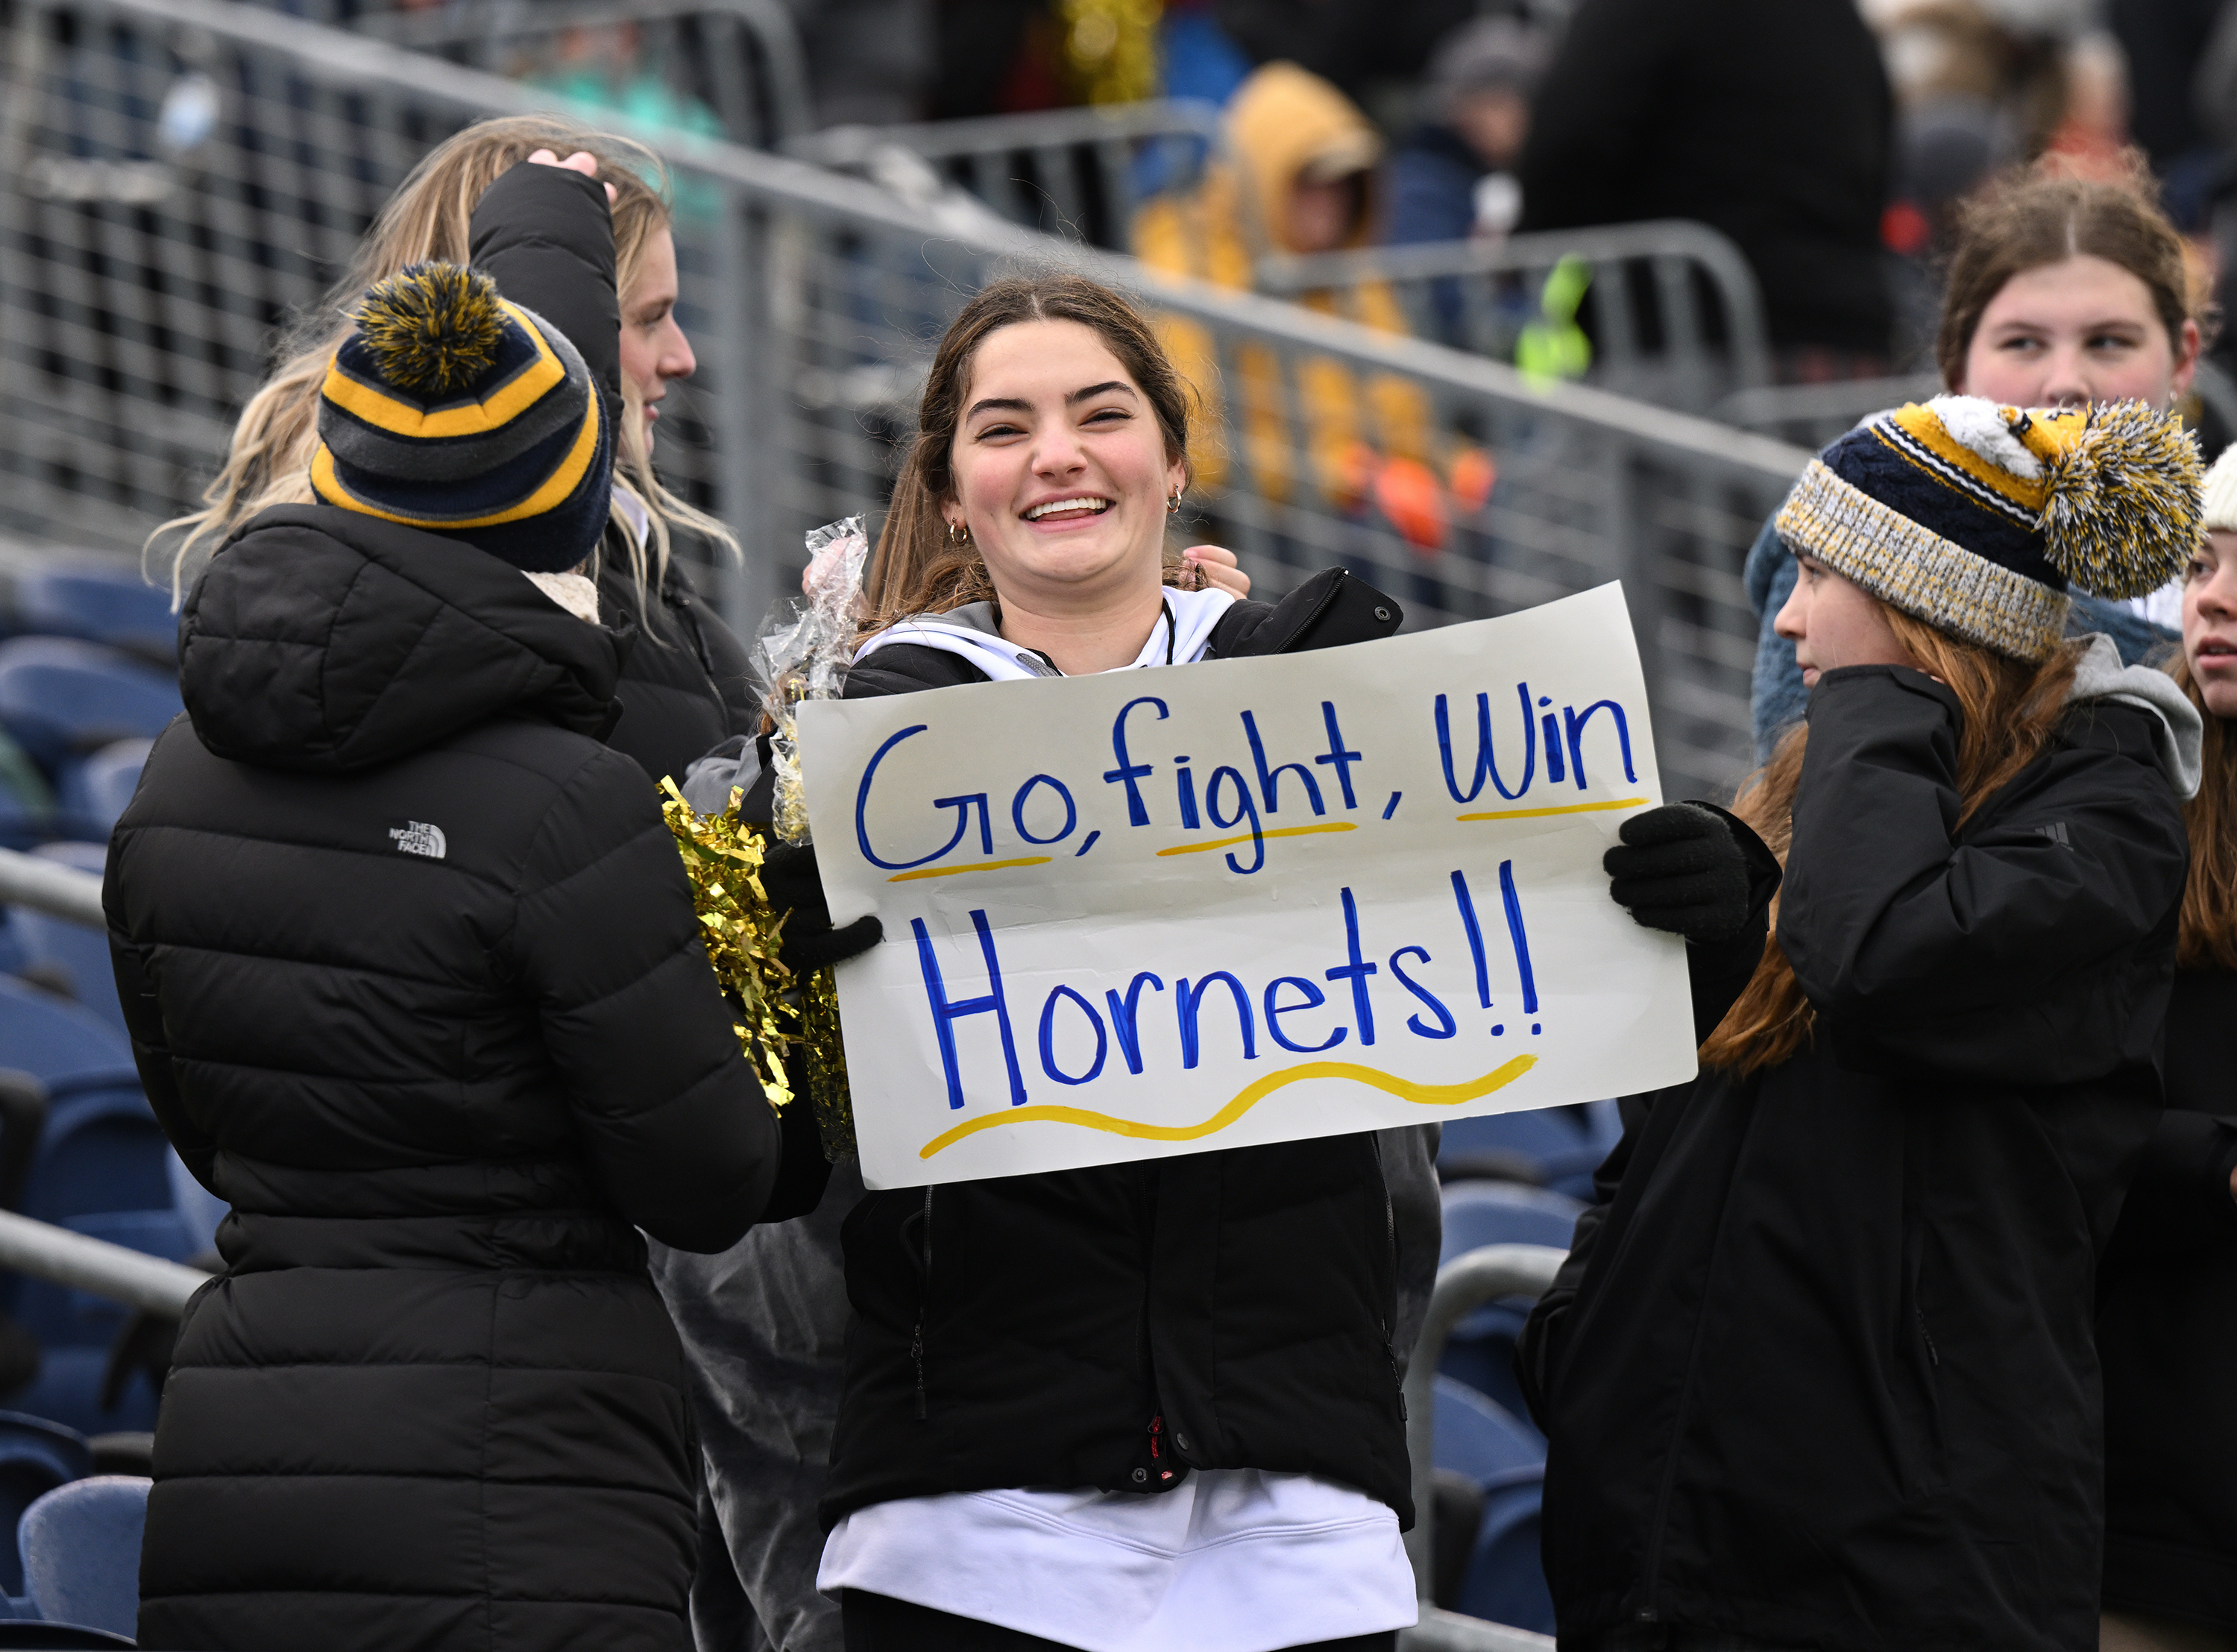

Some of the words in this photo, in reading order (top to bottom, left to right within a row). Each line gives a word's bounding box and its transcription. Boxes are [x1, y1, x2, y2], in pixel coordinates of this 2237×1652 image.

[855, 724, 1101, 872] Go,
[1102, 696, 1403, 875] fight,
[1434, 681, 1638, 804] Win
[408, 820, 431, 833] THE
[388, 827, 430, 844] NORTH
[397, 839, 426, 855] FACE
[910, 859, 1543, 1110] Hornets!!
